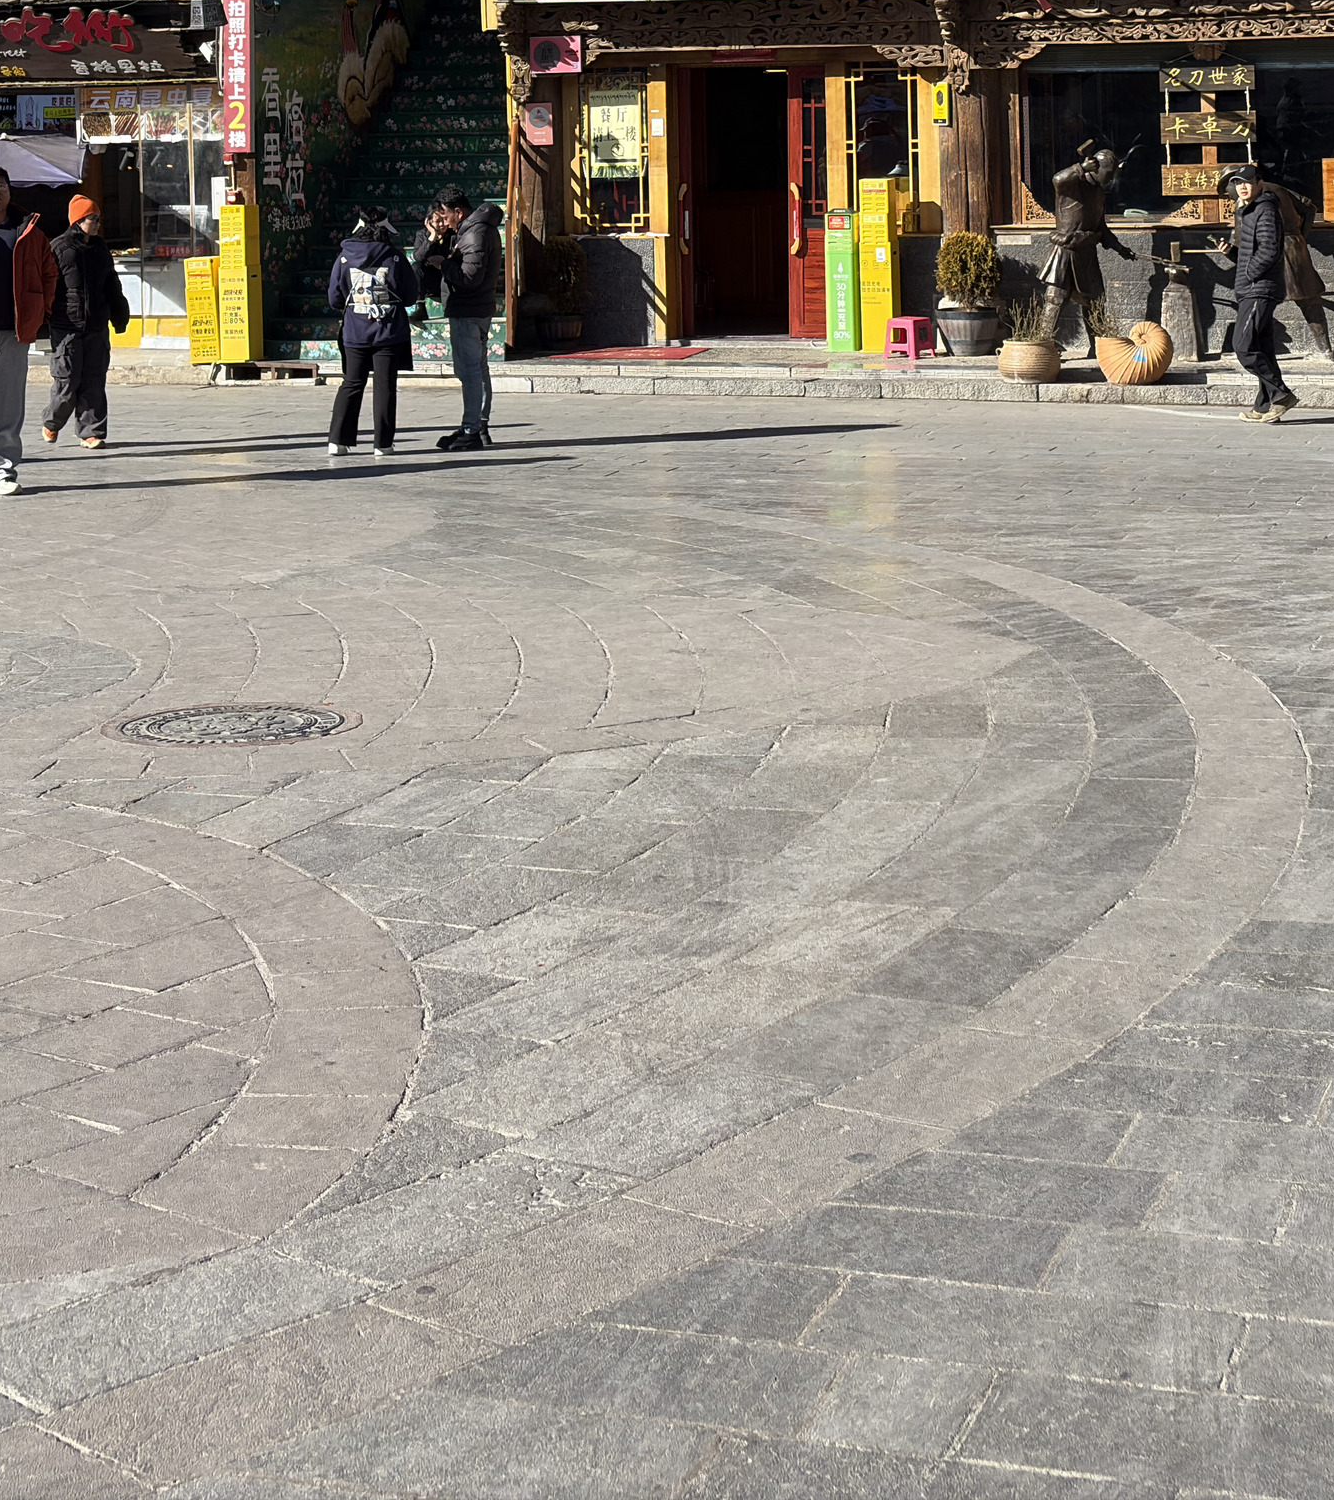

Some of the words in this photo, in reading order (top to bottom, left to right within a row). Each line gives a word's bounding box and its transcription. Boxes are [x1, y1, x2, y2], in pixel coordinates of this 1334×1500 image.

[70, 59, 166, 75] 香格里拉
[228, 0, 246, 148] 拍照打卡请上2楼
[1164, 64, 1251, 87] 名刀世家
[89, 86, 214, 110] 云南昆虫宴
[601, 107, 628, 123] 餐厅
[593, 125, 637, 143] 请上二楼
[1165, 116, 1250, 140] 卡卓刀
